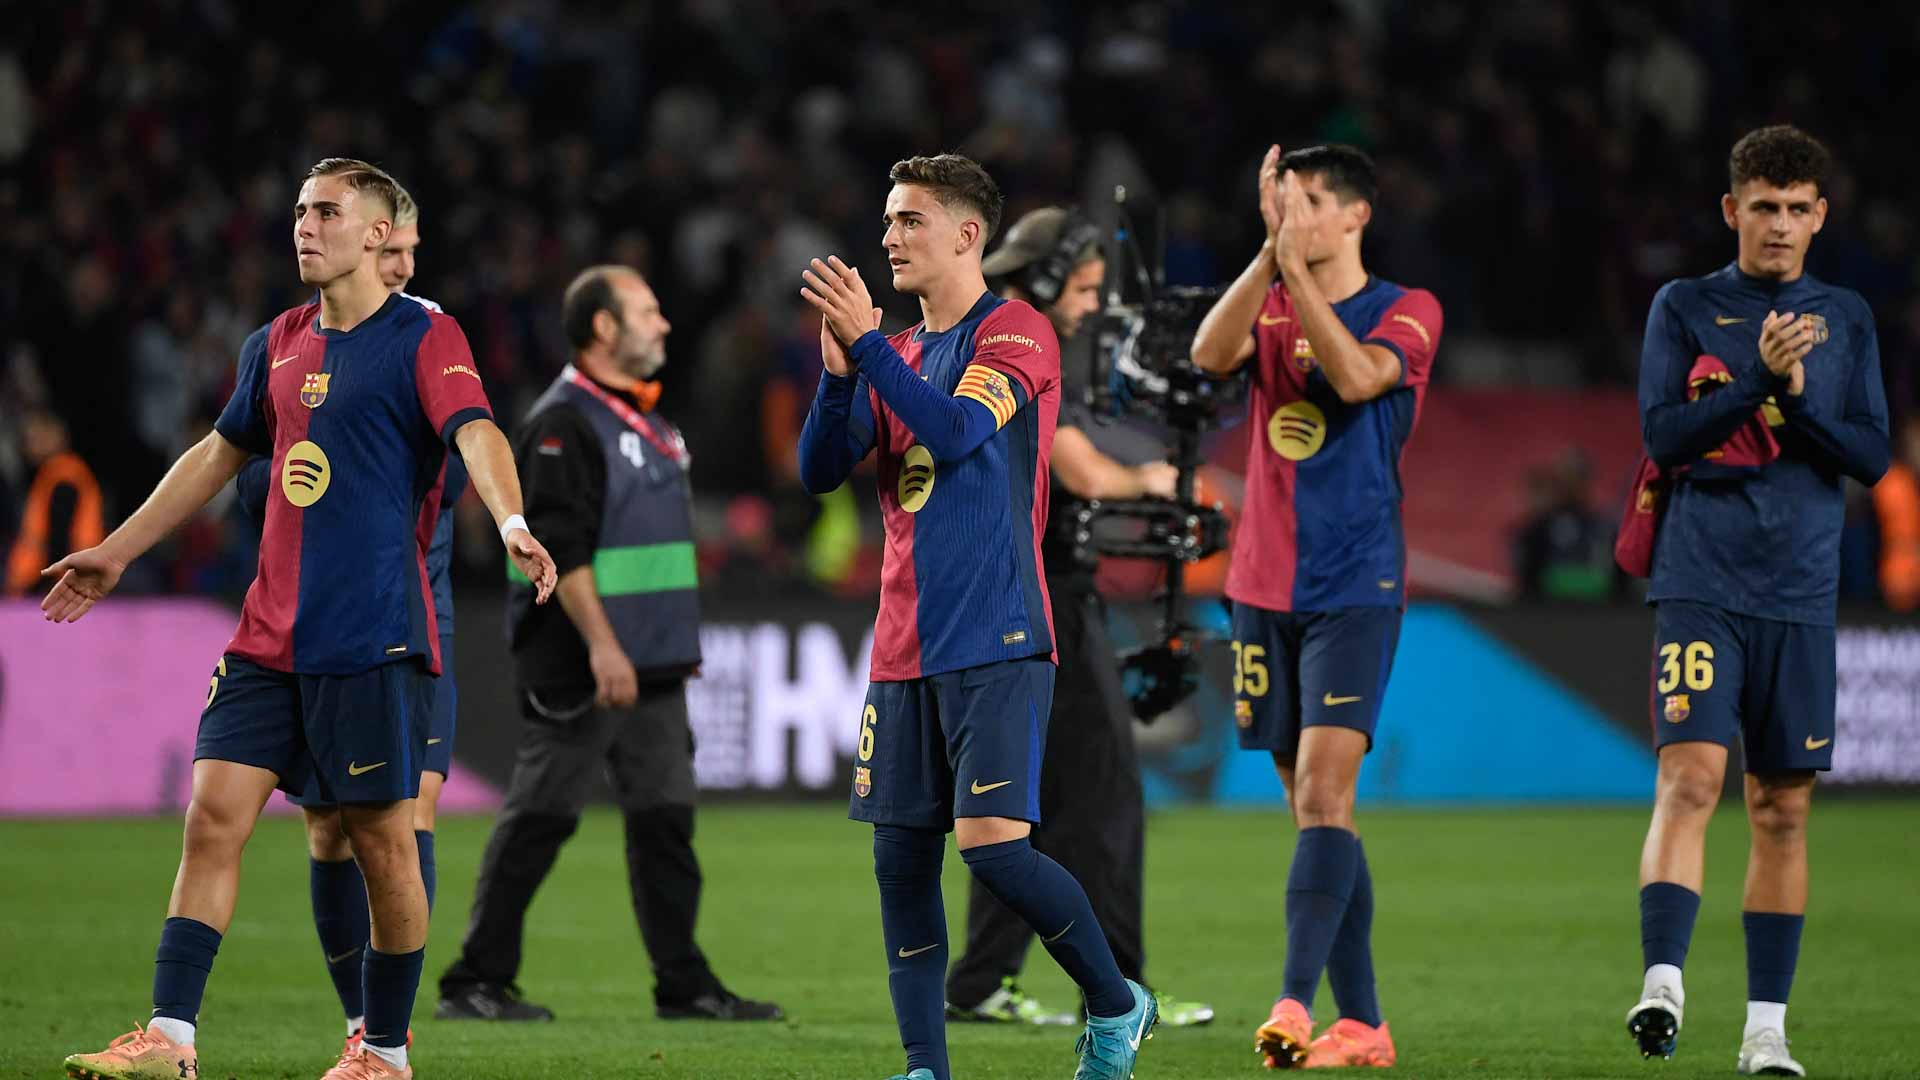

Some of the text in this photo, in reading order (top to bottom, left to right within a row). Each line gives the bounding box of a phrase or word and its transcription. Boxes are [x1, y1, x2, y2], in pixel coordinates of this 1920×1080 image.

[982, 334, 1034, 348] AMBILIGHT
[1657, 640, 1714, 694] 36
[858, 704, 877, 762] 6
